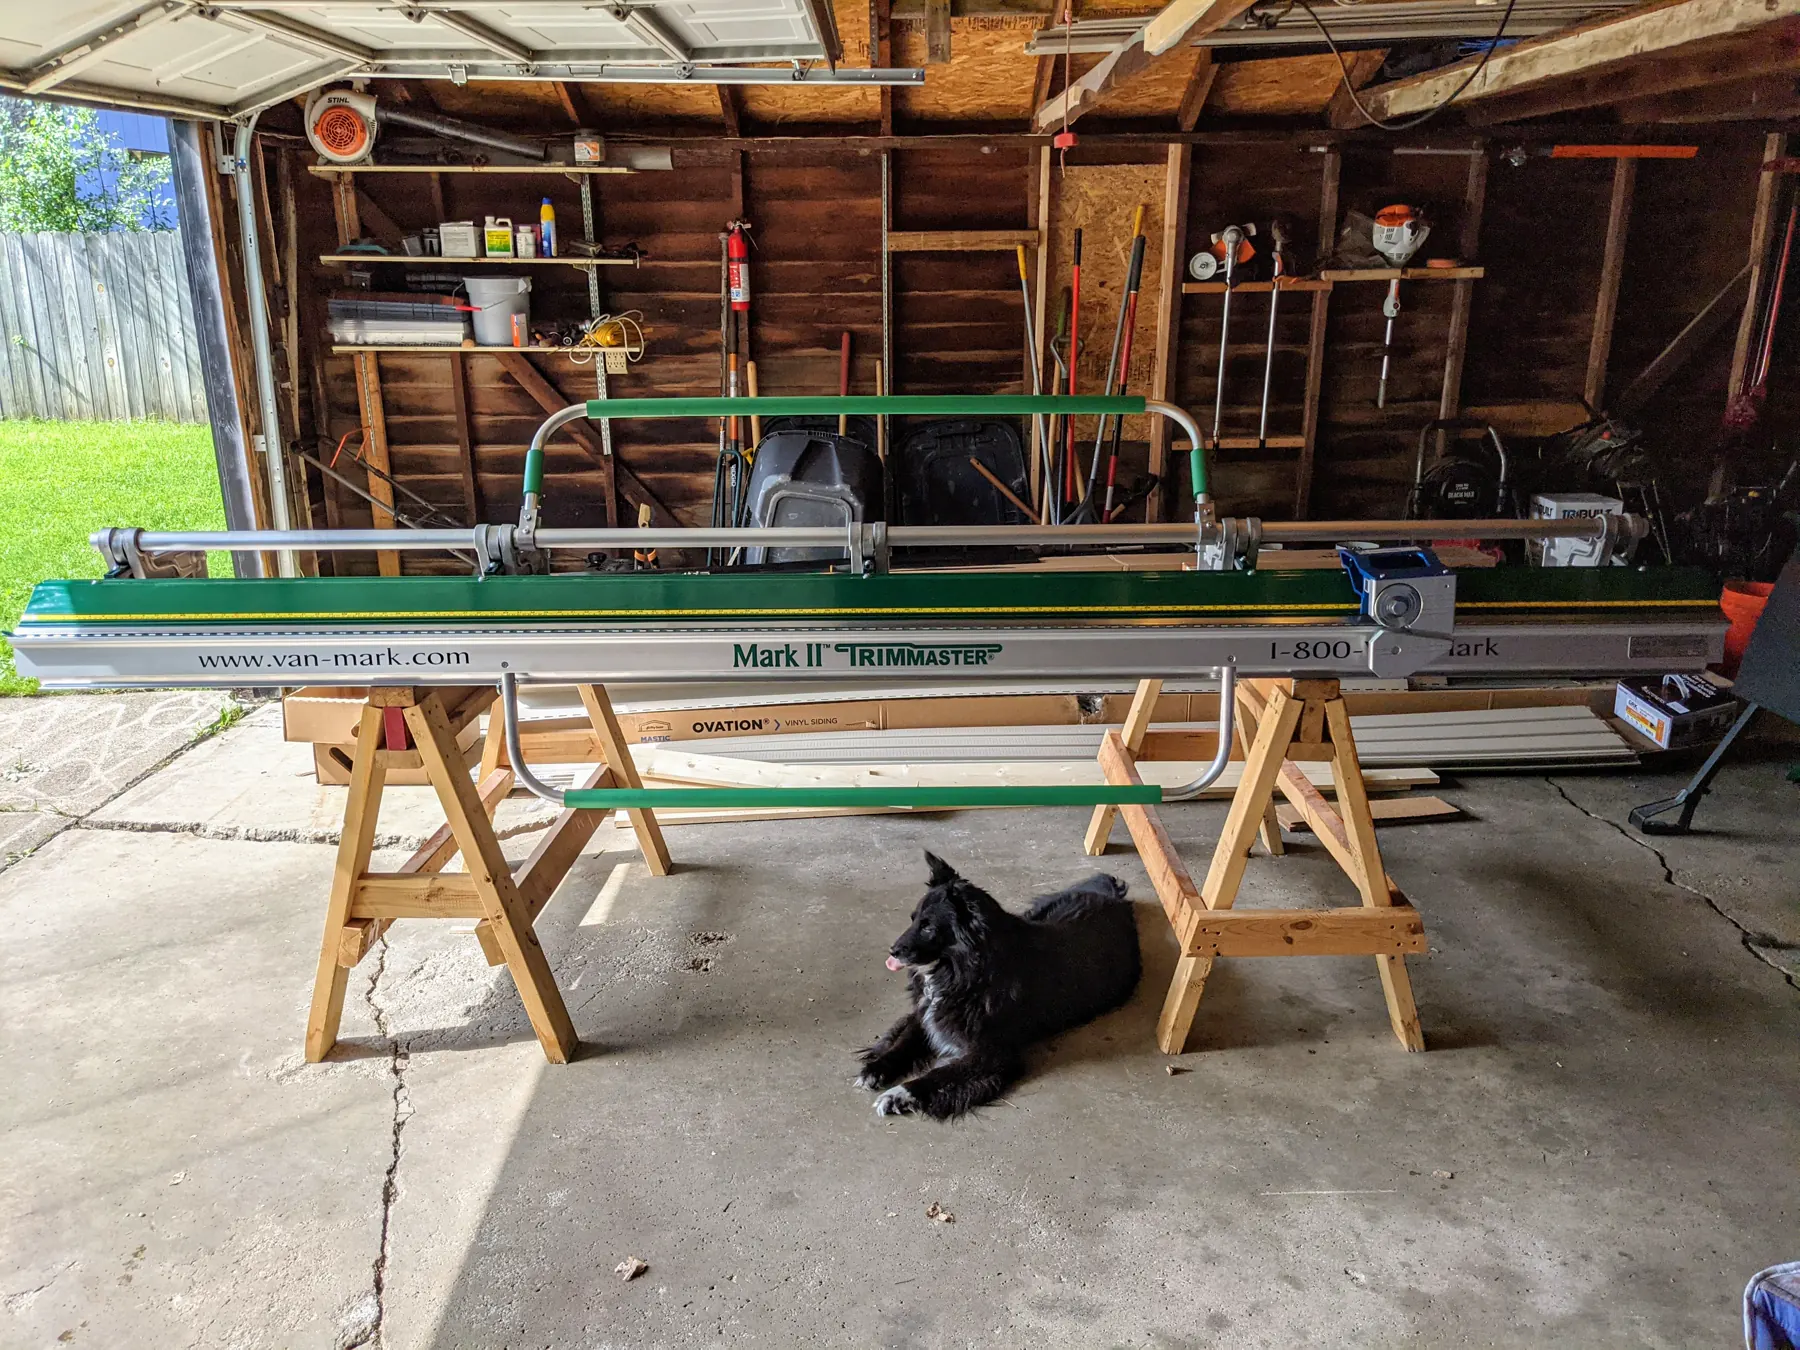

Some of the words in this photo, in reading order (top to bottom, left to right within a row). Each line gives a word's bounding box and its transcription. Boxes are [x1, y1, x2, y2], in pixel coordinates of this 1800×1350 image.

[733, 643, 800, 668] Mark
[1449, 637, 1499, 657] ark
[198, 647, 470, 668] www.van-mark.com
[784, 718, 809, 727] VINYL
[811, 717, 838, 726] SIDING
[640, 735, 671, 743] MASTIC
